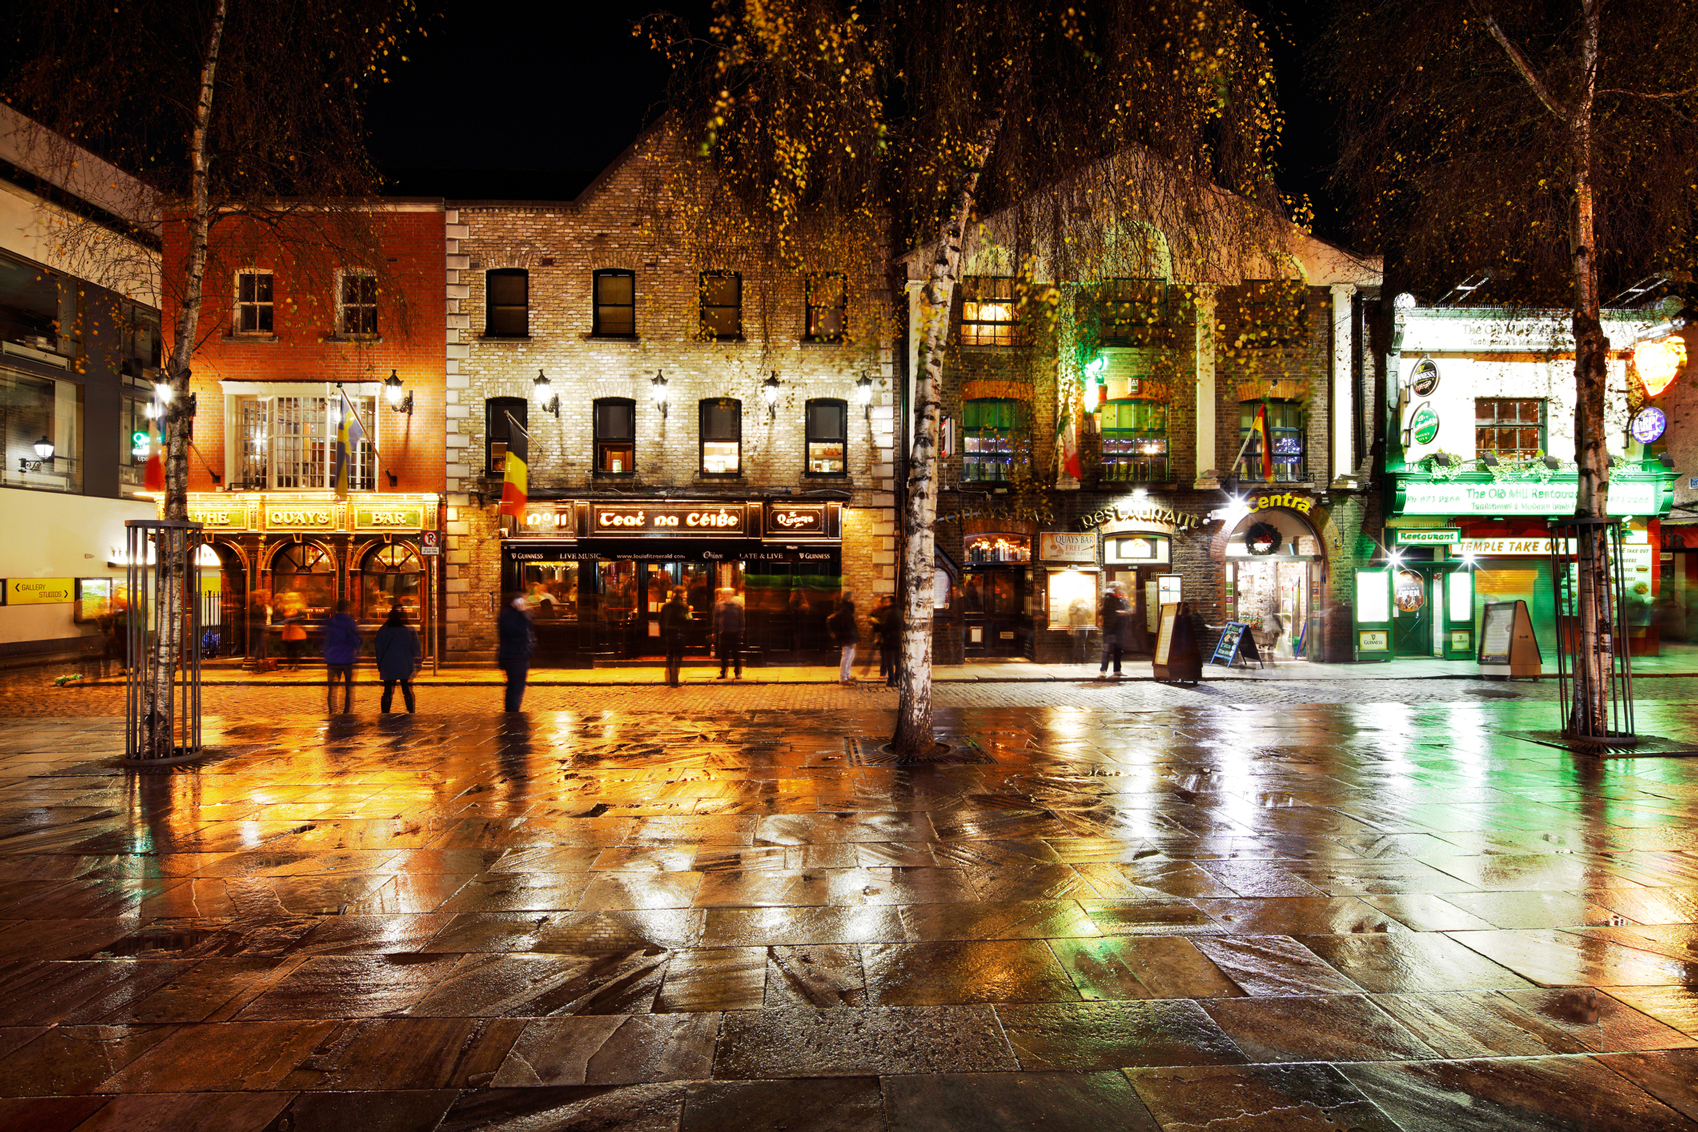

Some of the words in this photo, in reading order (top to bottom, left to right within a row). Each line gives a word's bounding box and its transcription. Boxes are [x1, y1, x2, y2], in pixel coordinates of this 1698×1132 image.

[1466, 488, 1486, 499] The
[1488, 488, 1507, 499] Old
[1509, 488, 1529, 499] Mill
[1246, 492, 1311, 513] Centra
[195, 512, 230, 525] THE
[371, 512, 406, 525] BAR
[944, 506, 1010, 525] QUAYS
[1015, 507, 1055, 526] BAR
[1055, 534, 1079, 545] QUAYS
[1080, 535, 1094, 544] BAR
[1460, 541, 1504, 552] TEMPLE
[1509, 541, 1540, 552] TAKE
[1363, 638, 1384, 646] GUINNESS
